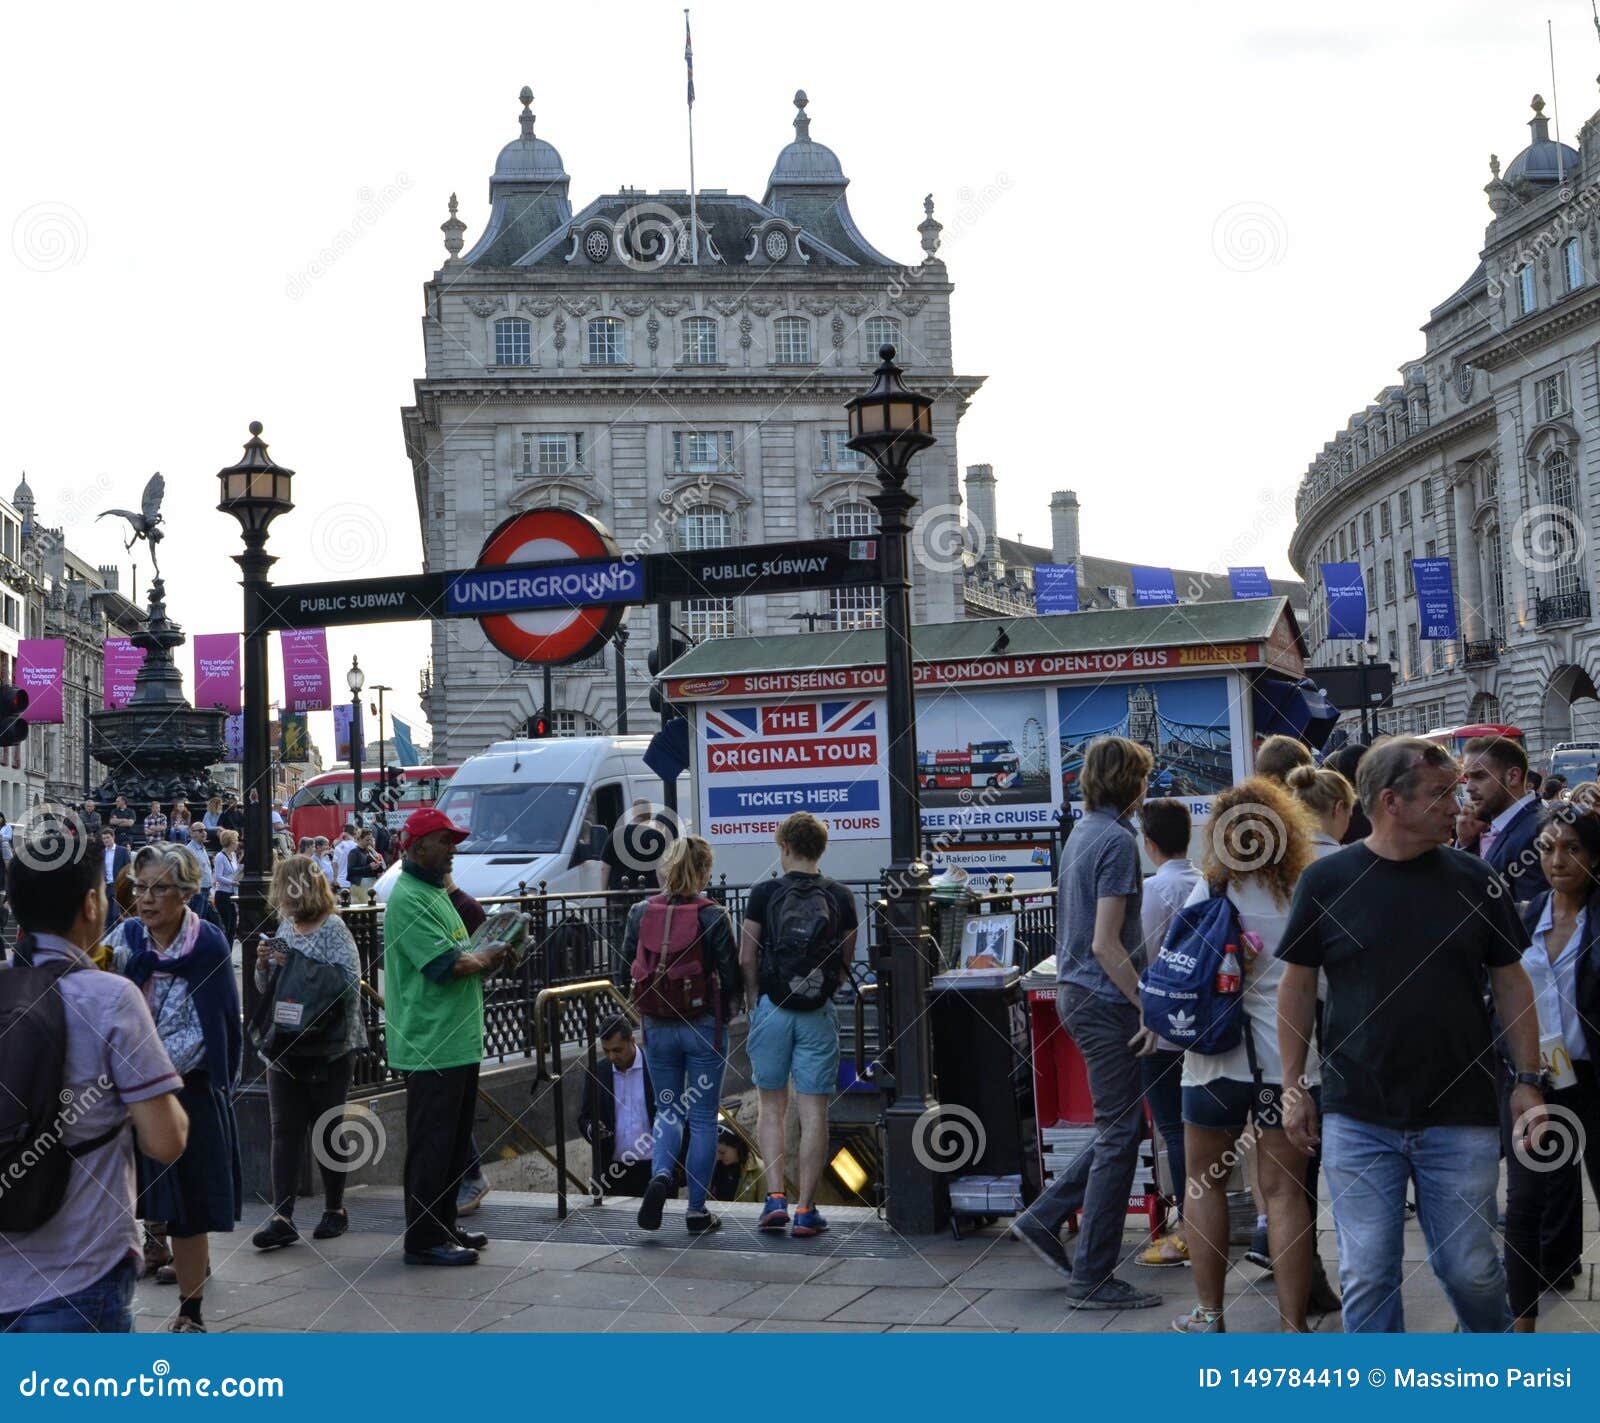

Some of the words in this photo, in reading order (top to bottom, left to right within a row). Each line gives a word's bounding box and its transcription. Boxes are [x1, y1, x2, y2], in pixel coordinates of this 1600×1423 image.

[703, 564, 756, 581] PUBLIC
[762, 557, 828, 576] SUBWAY
[454, 570, 636, 603] UNDERGROUND
[300, 596, 345, 612] PUBLIC
[350, 592, 406, 610] SUBWAY
[744, 672, 846, 691] SIGHTSEEING
[912, 666, 931, 681] OF
[937, 660, 1009, 680] LONDON
[1014, 658, 1036, 673] BY
[1040, 653, 1128, 672] OPEN-TOP
[1133, 651, 1168, 666] BUS
[1185, 647, 1244, 663] TICKETS
[768, 711, 810, 729] THE
[712, 747, 811, 766] ORIGINAL
[814, 743, 872, 761] TOUR
[737, 791, 804, 807] TICKETS
[807, 788, 849, 804] HERE
[711, 821, 780, 835] SIGHTSEE
[831, 818, 880, 830] TOURS
[920, 814, 945, 827] REE
[949, 812, 991, 826] RIVER
[994, 810, 1047, 824] CRUISE
[1051, 808, 1083, 822] AD
[989, 853, 1007, 862] line
[1036, 990, 1057, 1000] FREE
[1170, 1028, 1196, 1036] adidas
[1128, 1197, 1144, 1207] ONE
